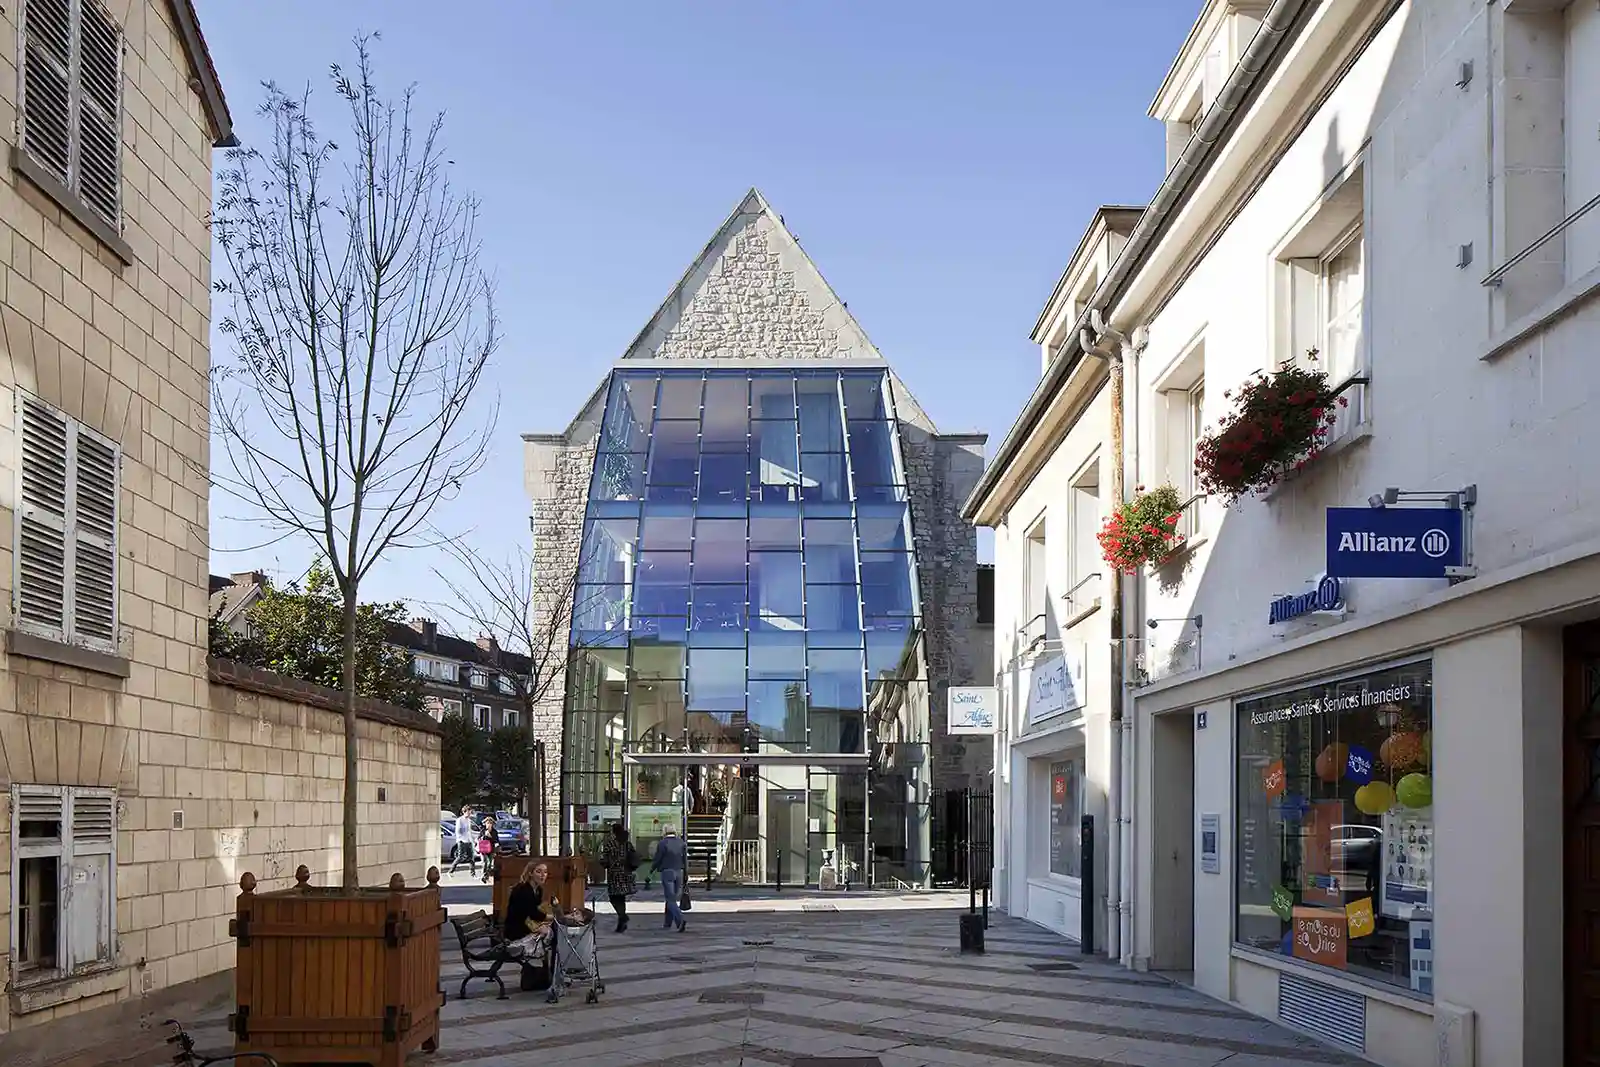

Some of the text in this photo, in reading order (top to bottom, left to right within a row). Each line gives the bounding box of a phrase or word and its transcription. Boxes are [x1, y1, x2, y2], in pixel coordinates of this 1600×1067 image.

[1338, 532, 1416, 552] Allianz
[1268, 590, 1317, 625] Allianz
[951, 692, 984, 704] Saint
[1291, 700, 1313, 719] Santé
[1314, 700, 1322, 714] &
[1323, 694, 1360, 712] Services
[1361, 684, 1411, 706] financiers
[1329, 922, 1341, 938] du
